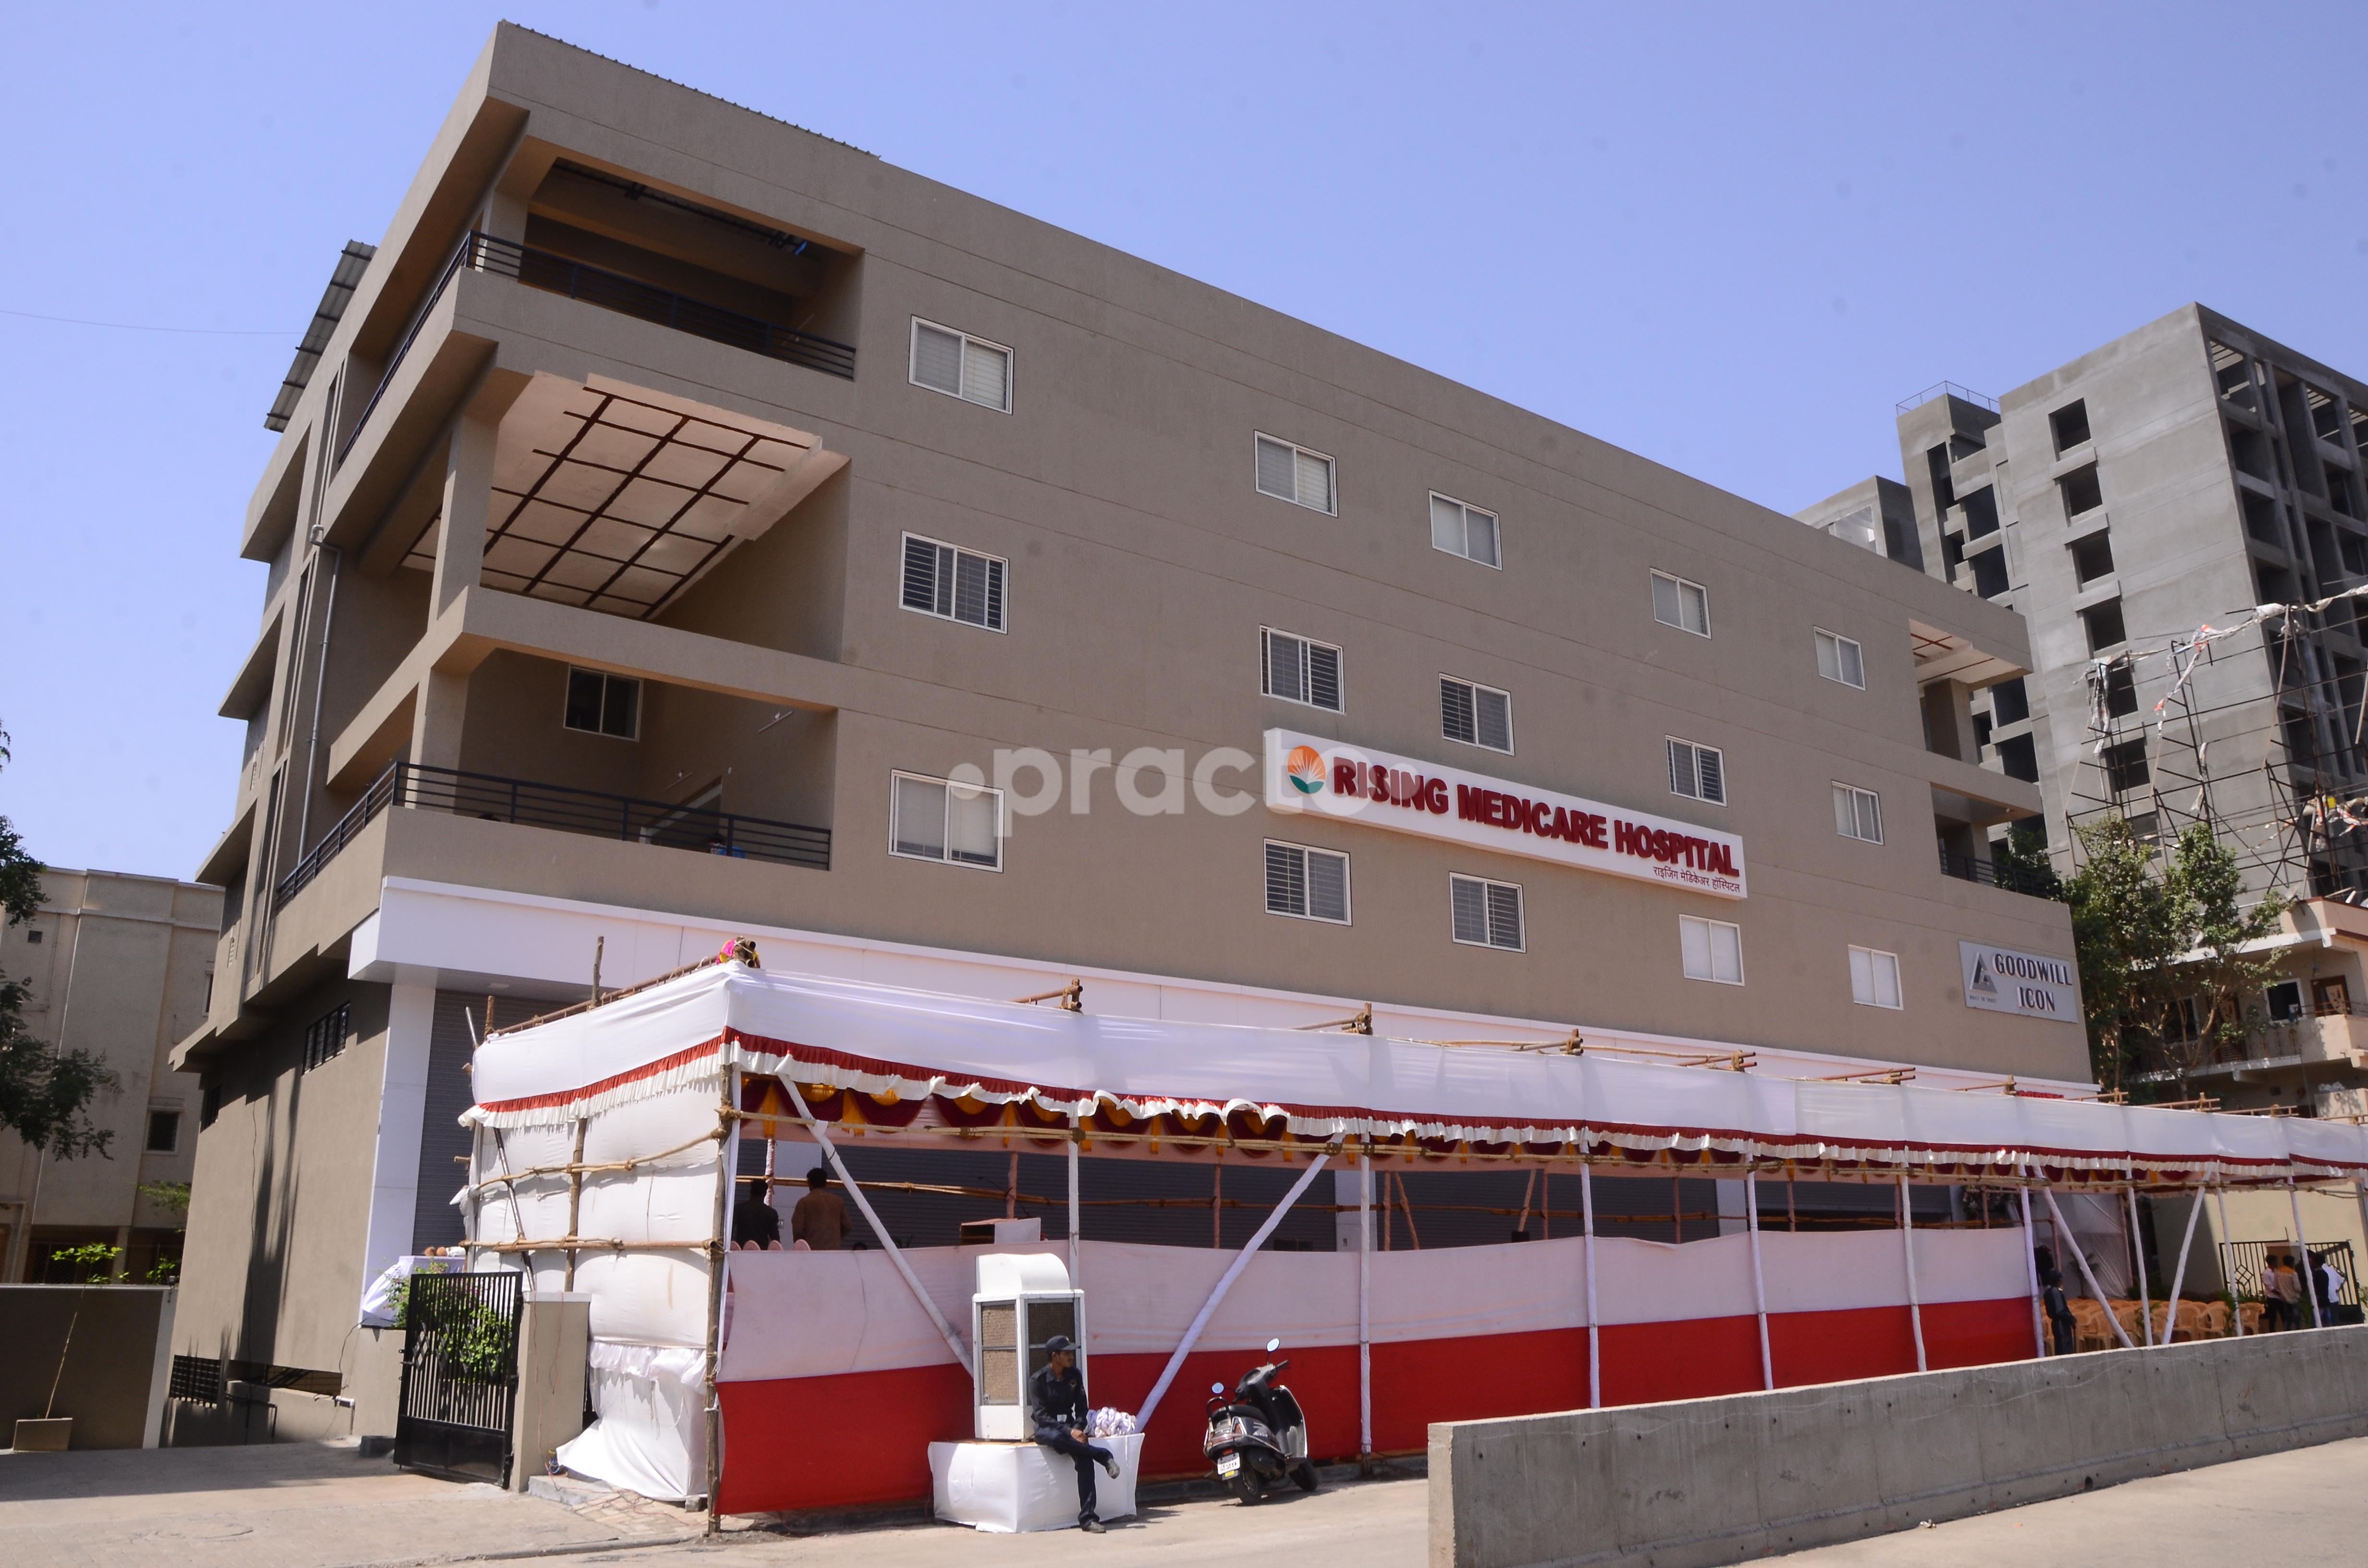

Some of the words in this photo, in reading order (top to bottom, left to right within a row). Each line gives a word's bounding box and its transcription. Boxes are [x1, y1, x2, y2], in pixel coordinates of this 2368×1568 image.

[1333, 756, 1449, 815] RISING
[1457, 784, 1609, 849] MEDICARE
[1614, 820, 1739, 877] HOSPITAL
[1712, 876, 1740, 893] हॉस्पिटल
[1993, 953, 2072, 986] GOODWILL
[2018, 986, 2055, 1012] ICON
